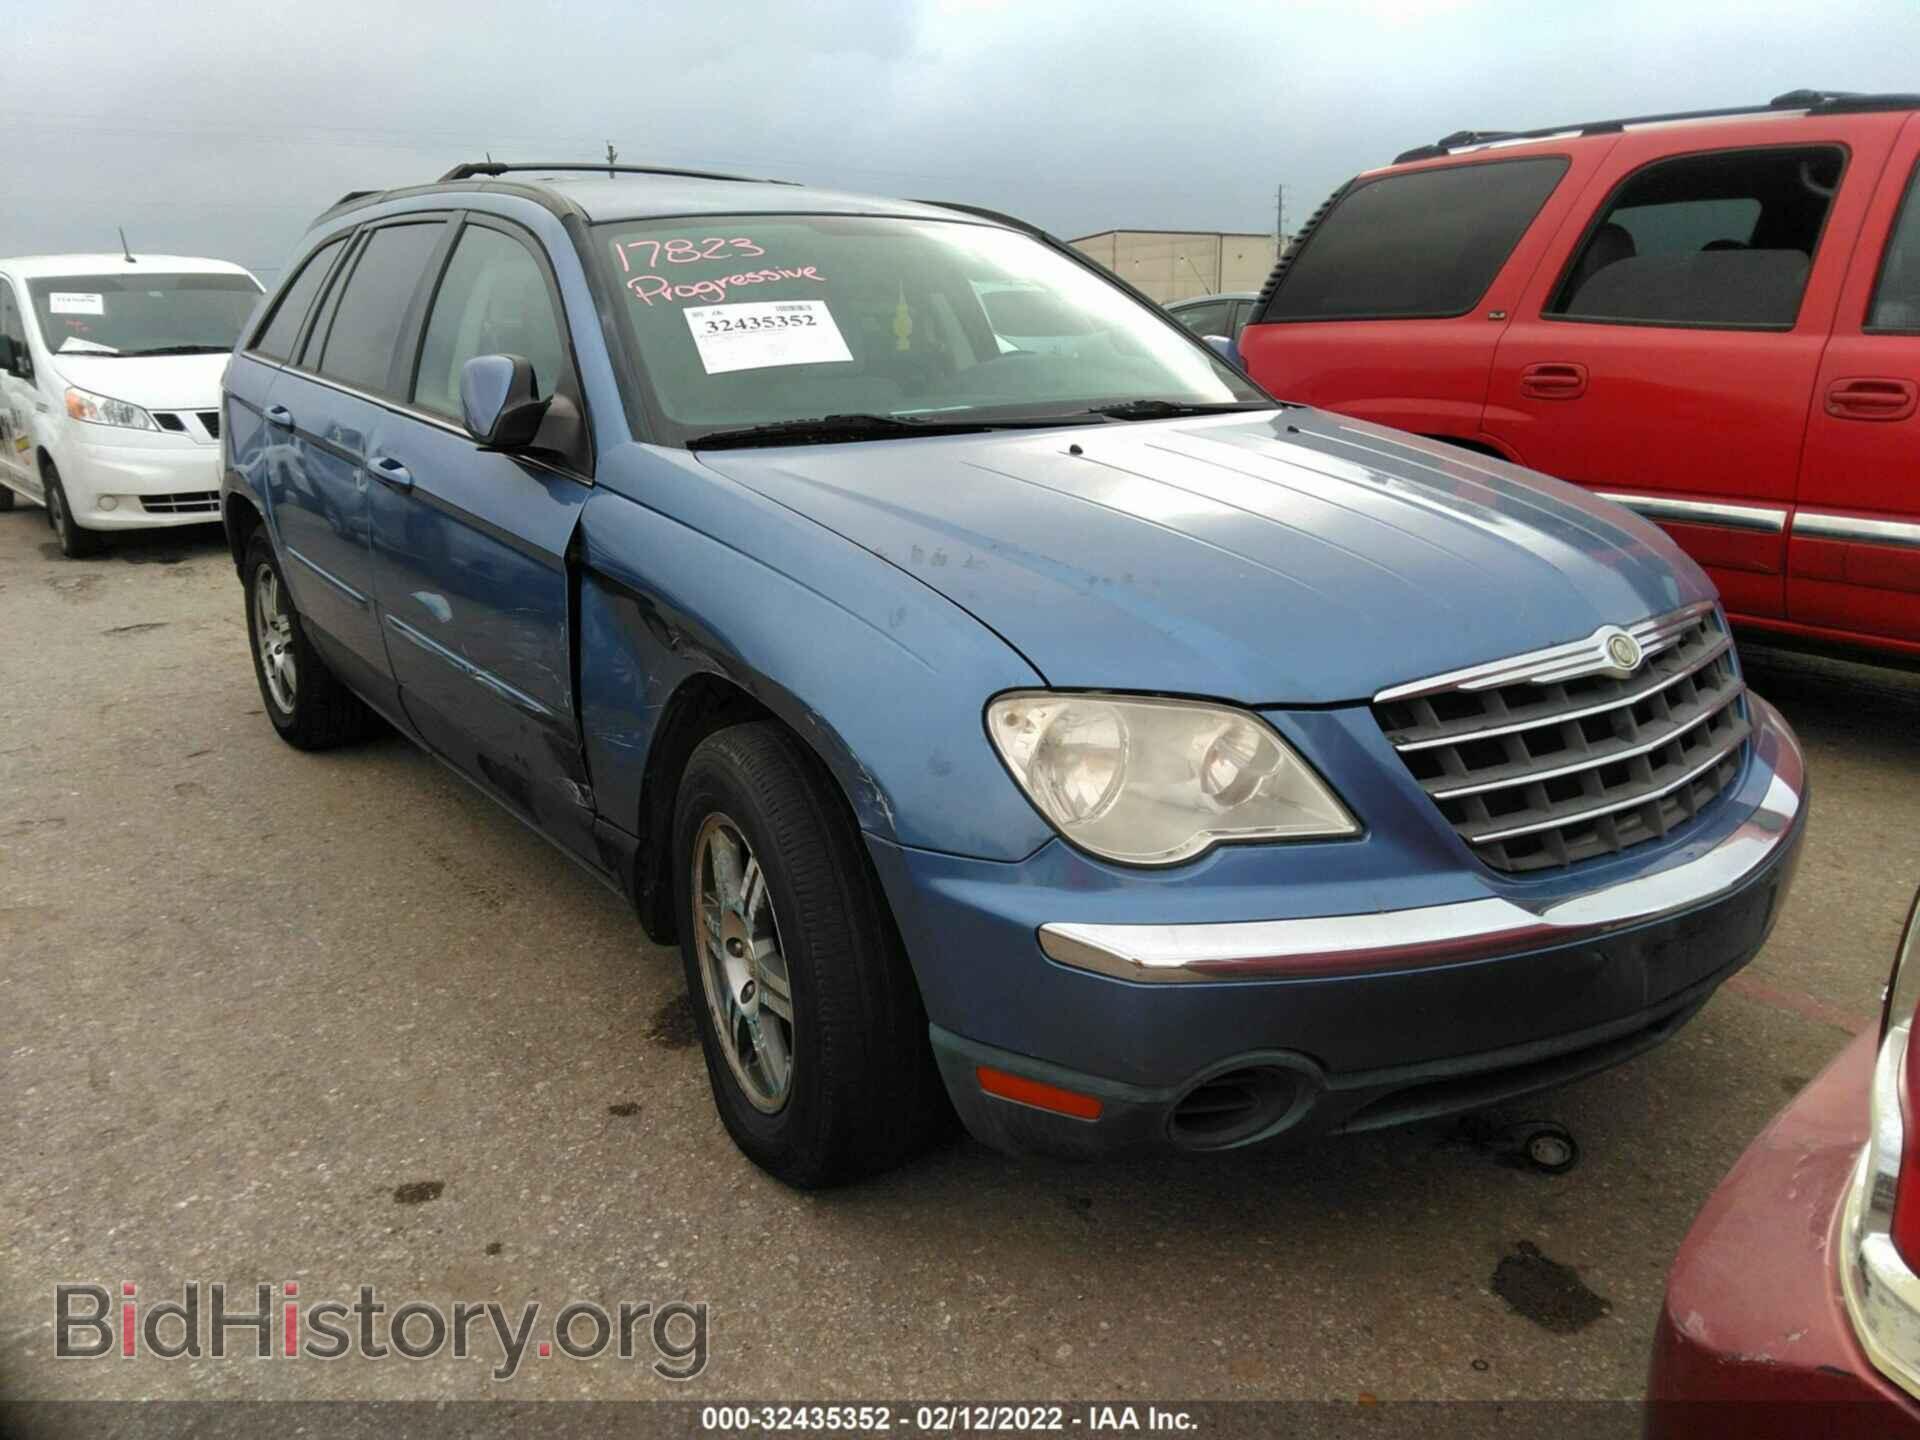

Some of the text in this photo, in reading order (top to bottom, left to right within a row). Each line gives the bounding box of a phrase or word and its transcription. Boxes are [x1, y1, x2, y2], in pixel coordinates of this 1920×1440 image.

[615, 238, 765, 272] 17823
[627, 266, 826, 306] Progressive
[704, 314, 817, 334] 32435352
